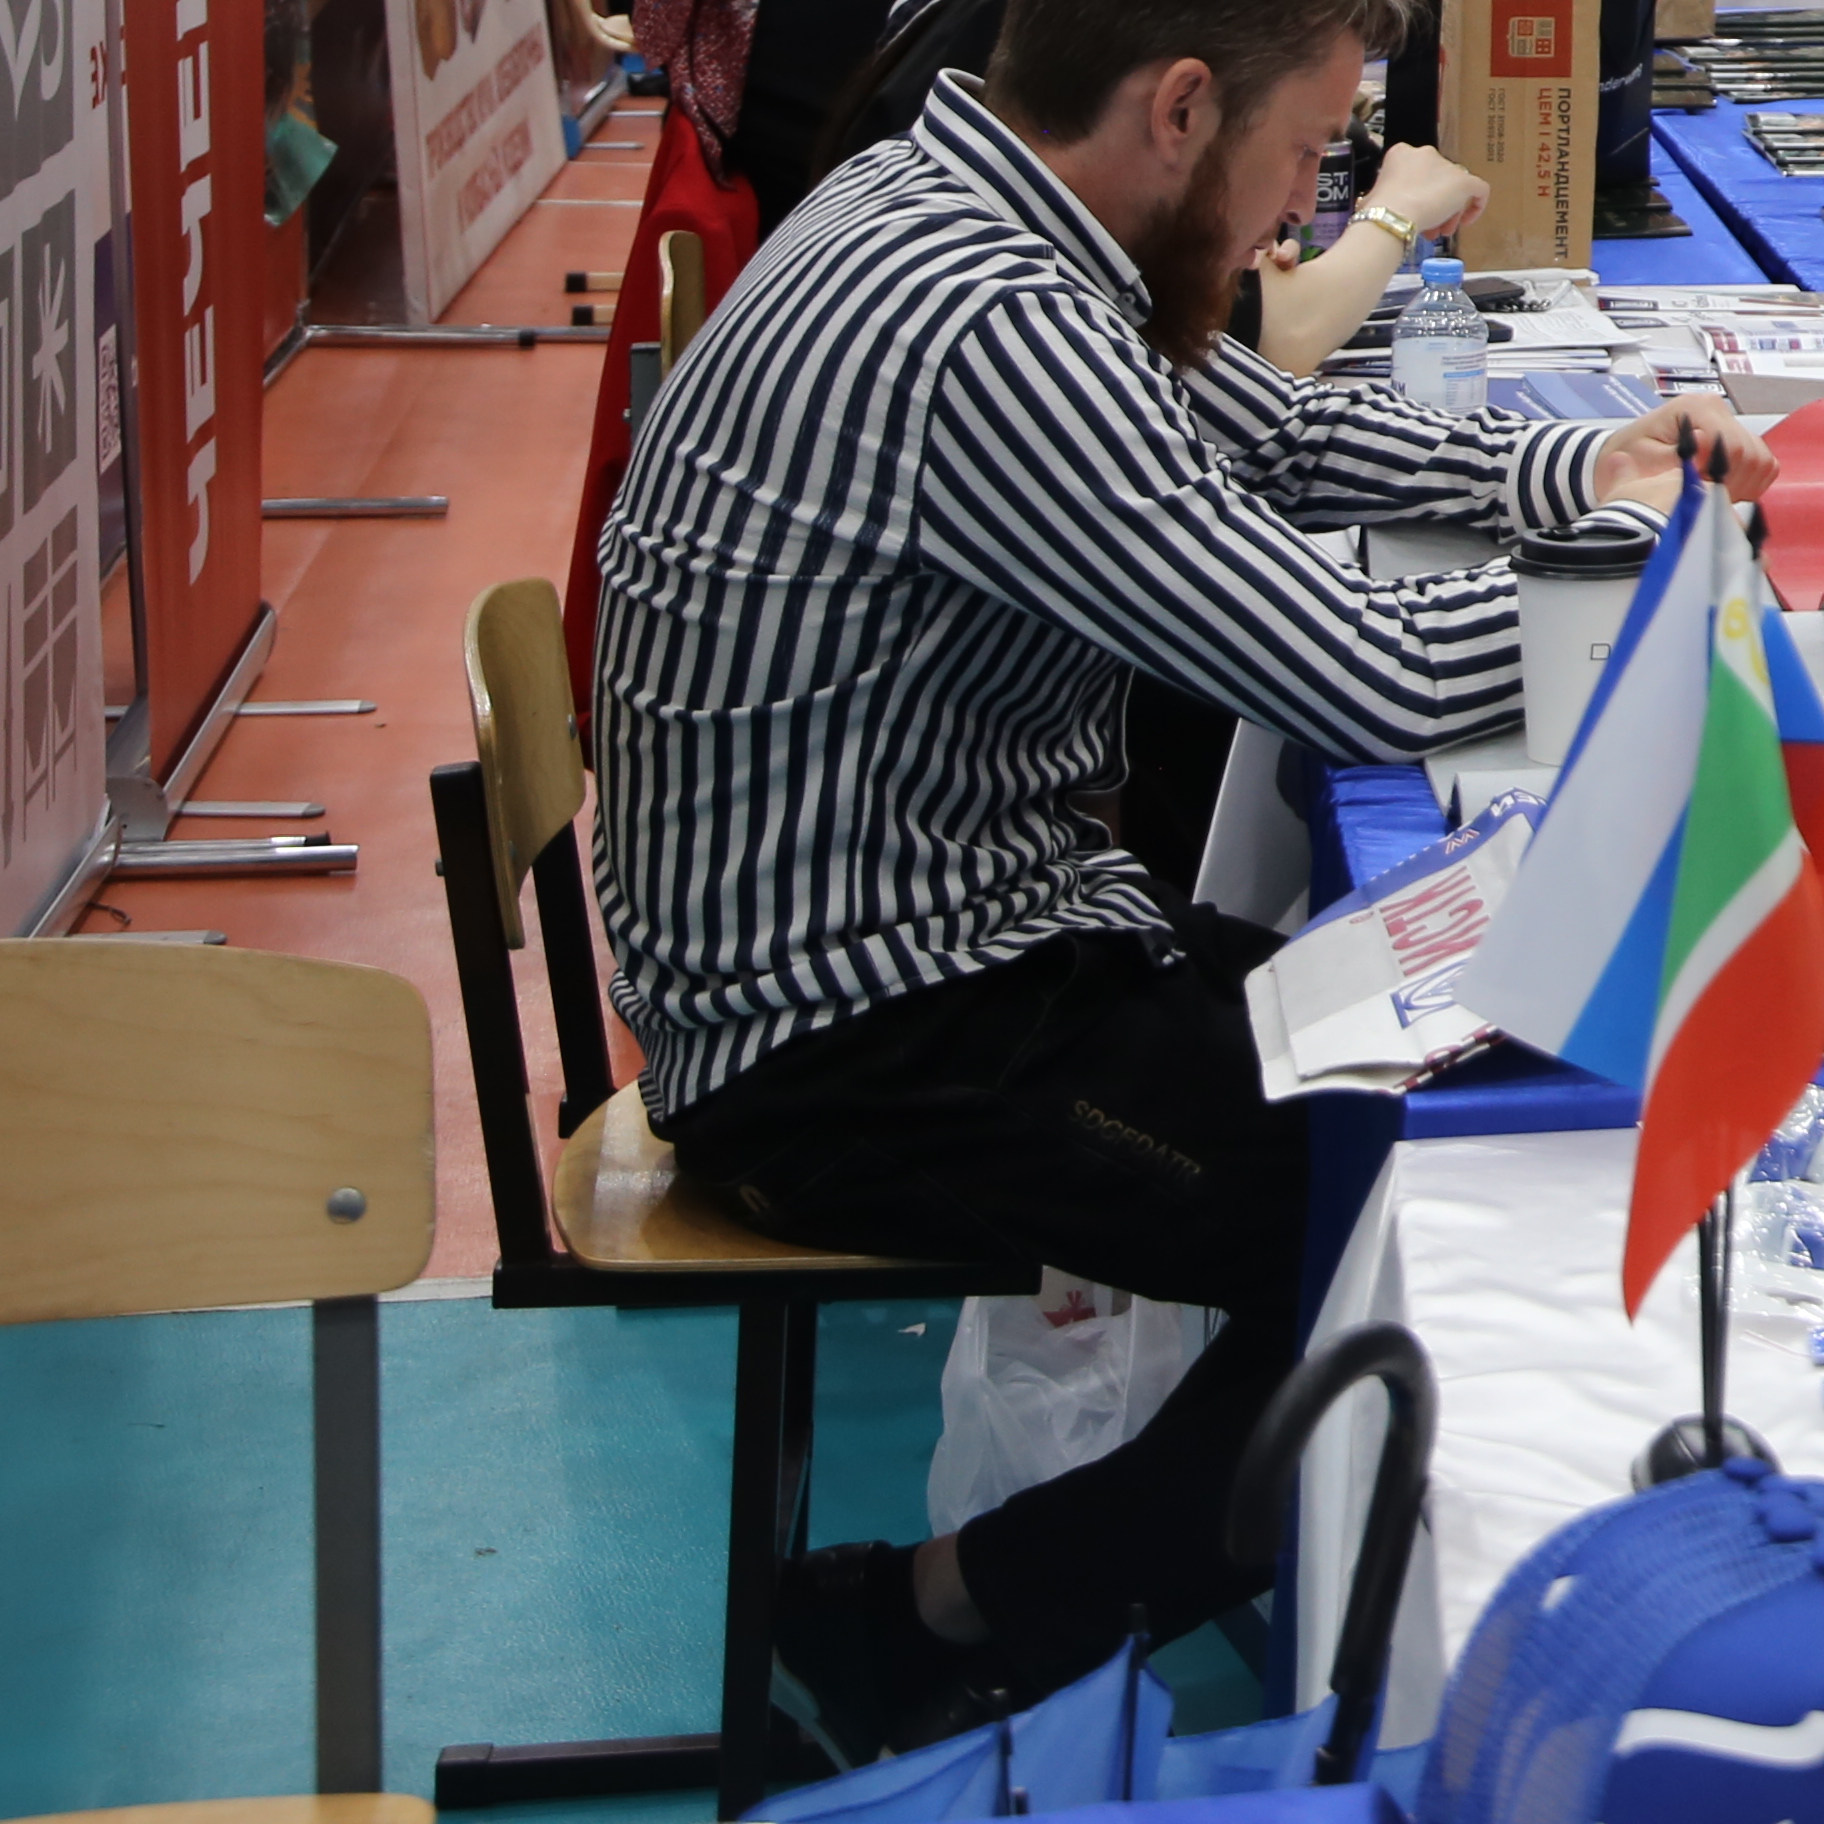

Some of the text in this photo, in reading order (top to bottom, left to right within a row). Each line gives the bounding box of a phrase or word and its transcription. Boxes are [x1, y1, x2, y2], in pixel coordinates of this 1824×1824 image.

[1487, 87, 1497, 111] ГОСТ
[1497, 87, 1506, 111] ГОСТ
[1537, 87, 1553, 125] ЦЕМ
[1536, 142, 1551, 179] 42,5
[1553, 87, 1572, 259] ПОРТЛАНДЦЕМЕНТ
[1537, 185, 1550, 197] Н
